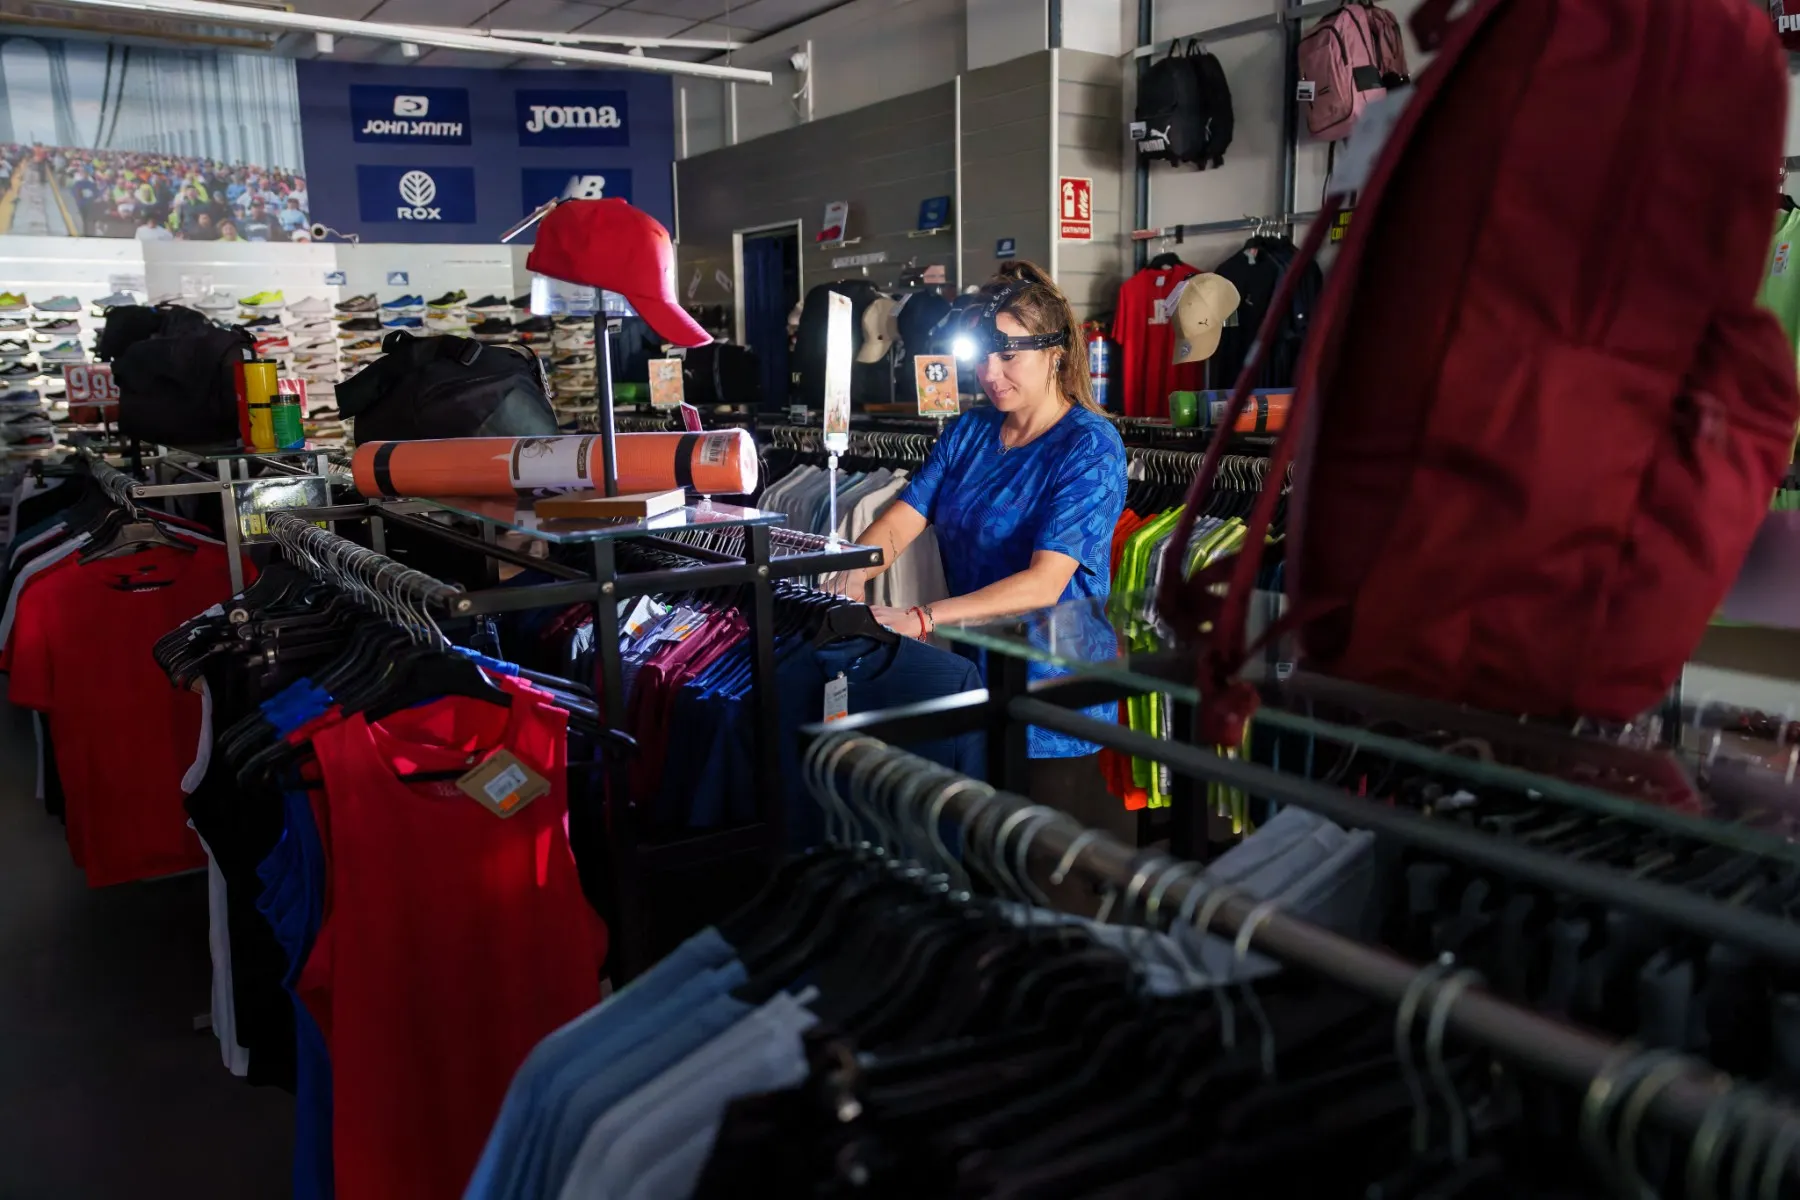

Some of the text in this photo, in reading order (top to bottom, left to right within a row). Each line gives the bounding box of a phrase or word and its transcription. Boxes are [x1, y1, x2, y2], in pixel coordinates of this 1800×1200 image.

[362, 119, 463, 136] JOHN SMITH
[396, 206, 442, 220] ROX
